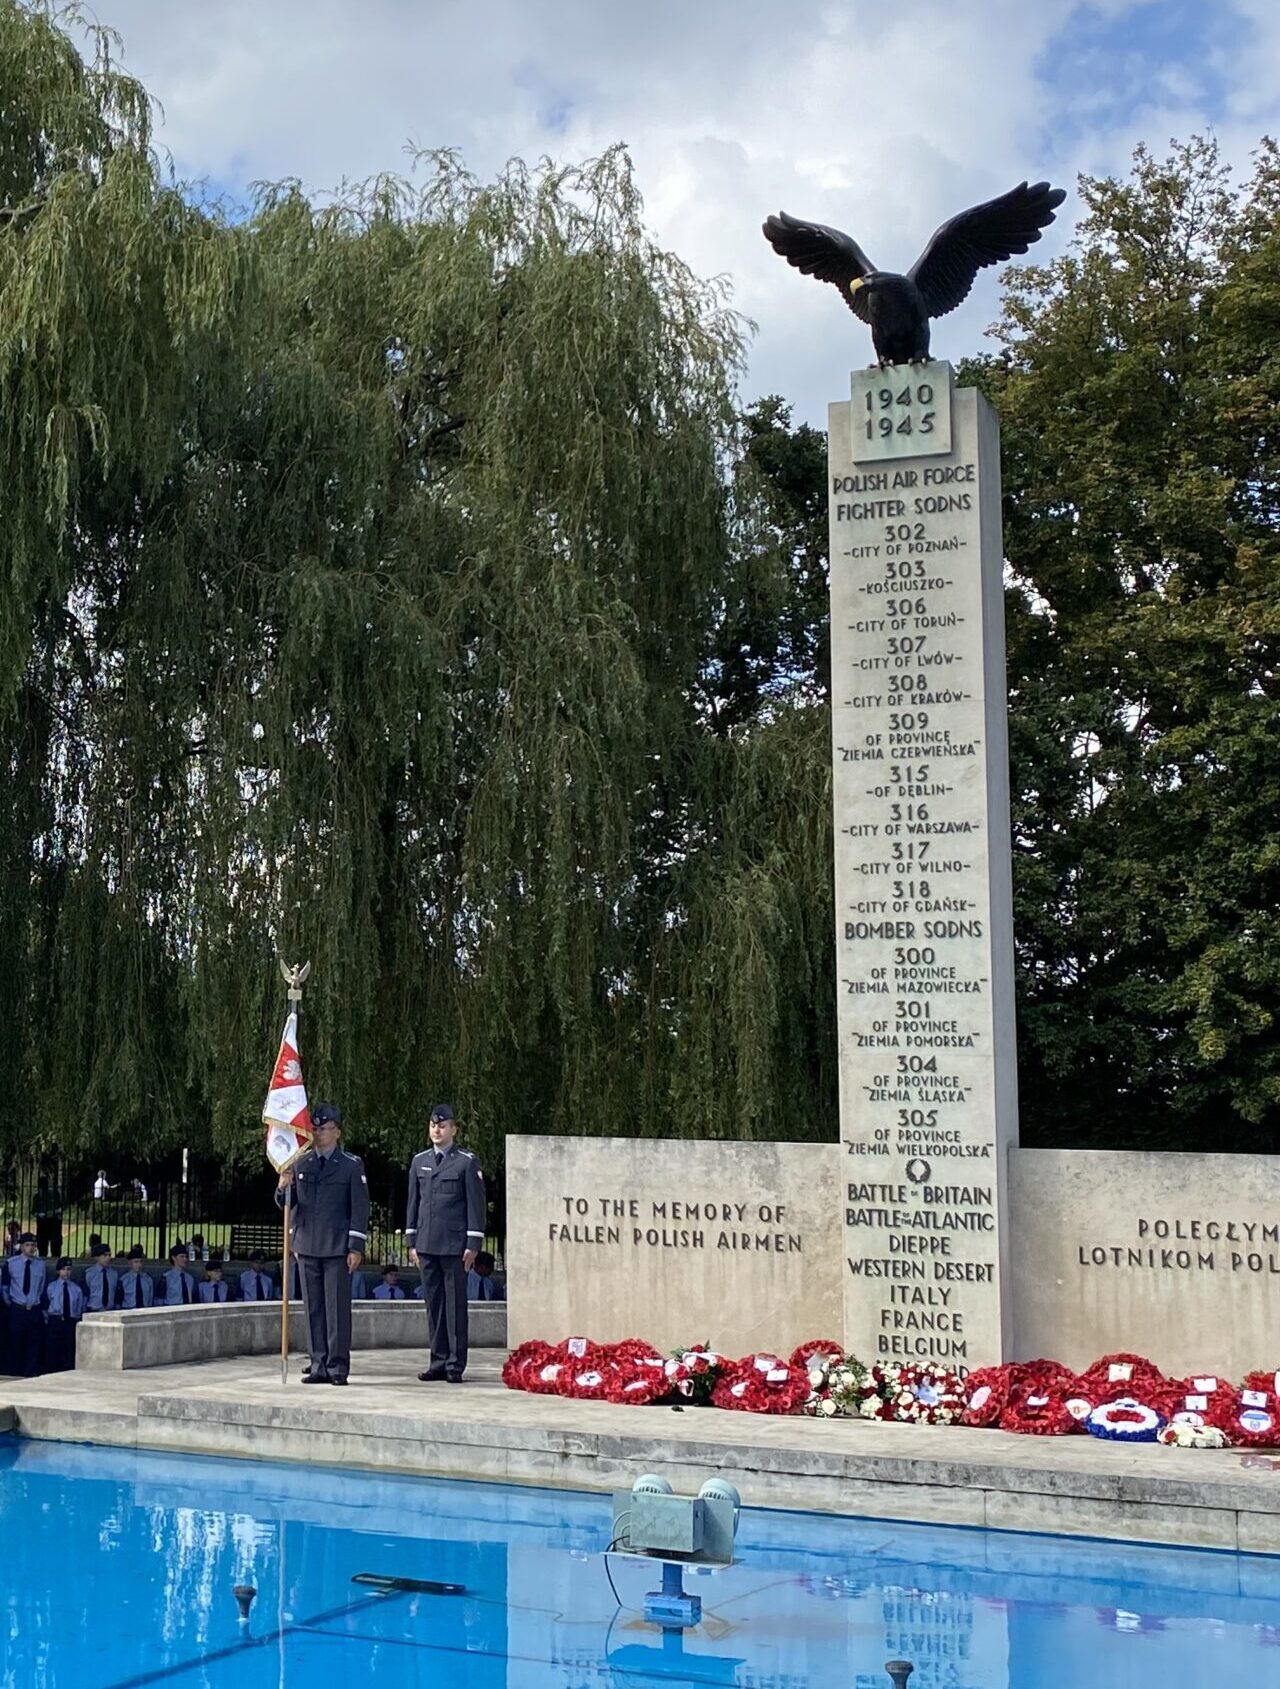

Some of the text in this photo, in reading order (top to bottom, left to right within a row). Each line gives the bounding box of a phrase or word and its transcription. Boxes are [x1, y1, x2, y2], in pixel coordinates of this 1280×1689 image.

[865, 384, 933, 411] 1940
[865, 413, 935, 439] 1945
[833, 464, 975, 494] POLISH AIR FORCE
[837, 494, 972, 521] FIGHTER SQDNS
[885, 523, 925, 542] 302
[886, 545, 901, 555] OF
[885, 560, 926, 579] 303
[886, 598, 927, 616] 306
[891, 619, 907, 630] OF
[887, 636, 927, 655] 307
[895, 656, 911, 667] OF
[888, 674, 927, 692] 308
[888, 694, 903, 706] OF
[889, 712, 928, 730] 309
[866, 731, 950, 746] OF PROVINCE
[890, 765, 929, 783] 315
[890, 804, 929, 821] 316
[885, 824, 901, 835] OF
[891, 842, 930, 860] 317
[896, 862, 913, 873] OF
[892, 881, 930, 899] 318
[893, 902, 909, 912] OF
[844, 921, 983, 940] BOMBER SQDNS
[894, 948, 935, 965] 300
[871, 967, 956, 979] OF PROVINCE
[895, 1001, 930, 1018] 301
[873, 1021, 957, 1032] OF PROVINCE
[897, 1056, 937, 1073] 304
[874, 1076, 959, 1088] OF PROVINCE
[898, 1109, 938, 1127] 305
[875, 1129, 961, 1143] OF PROVINCE
[848, 1183, 992, 1205] BATTLE BRITAIN
[562, 1197, 786, 1224] TO THE MEMORY OF
[846, 1208, 901, 1228] BATTLE
[912, 1211, 994, 1231] ATLANTIC
[549, 1224, 802, 1252] FALLEN POLISH AIRMEN
[1138, 1219, 1279, 1242] POLEGŁYM
[889, 1235, 951, 1255] DIEPPE
[1079, 1246, 1214, 1271] LOTNIKOM
[848, 1258, 994, 1282] WESTERN DESERT
[890, 1285, 951, 1305] ITALY
[881, 1310, 963, 1332] FRANCE
[878, 1335, 966, 1357] BELGIUM
